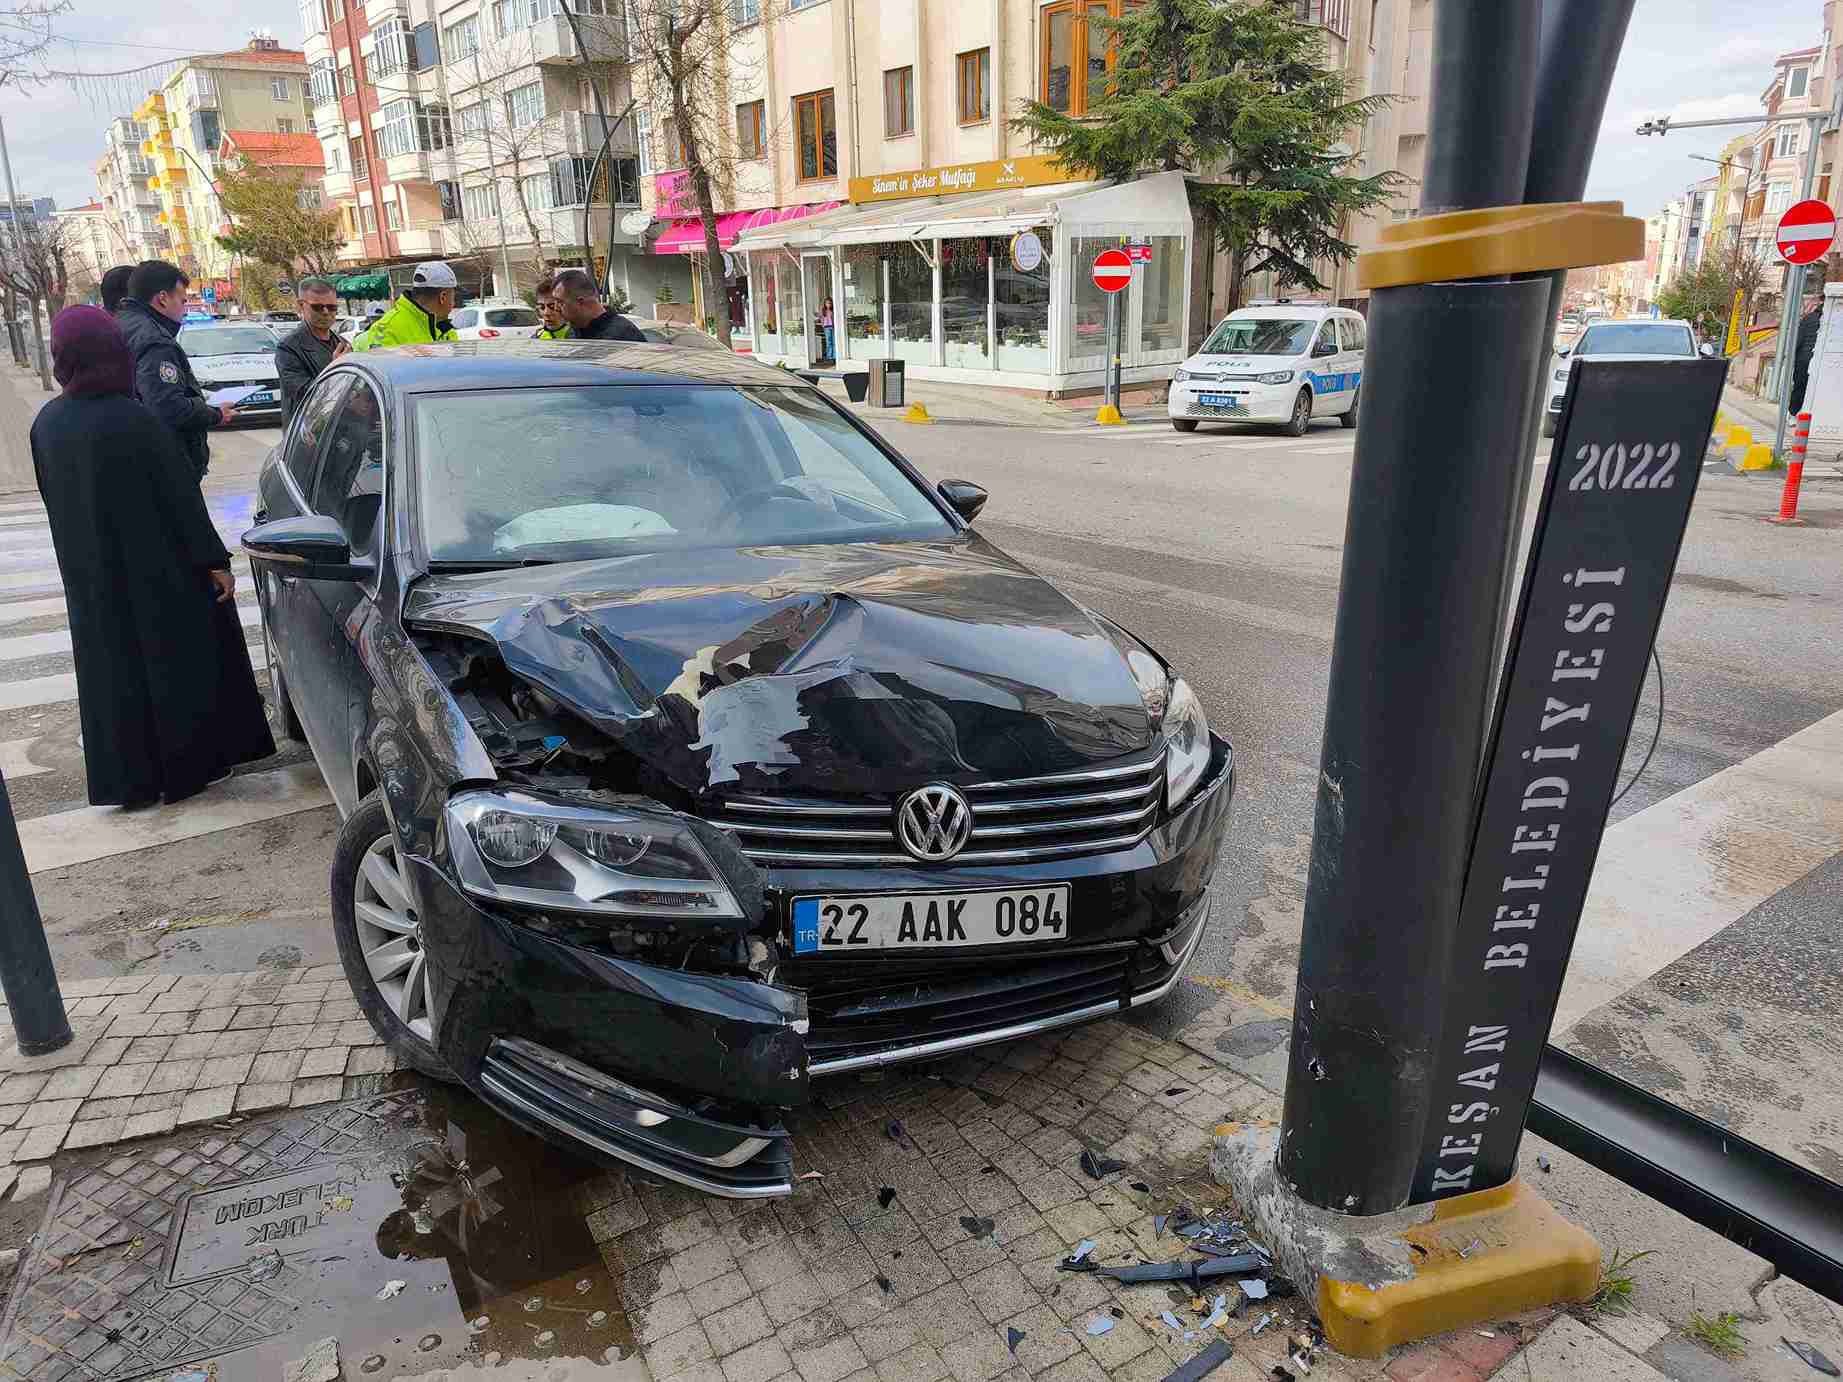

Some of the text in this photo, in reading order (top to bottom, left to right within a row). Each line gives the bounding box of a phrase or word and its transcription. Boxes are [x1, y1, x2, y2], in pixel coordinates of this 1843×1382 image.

[1568, 441, 1681, 491] 2022
[1432, 566, 1626, 1192] KEŞAN BELEDİYESİ
[798, 930, 815, 942] TR
[822, 892, 1064, 945] 22 AAK 084
